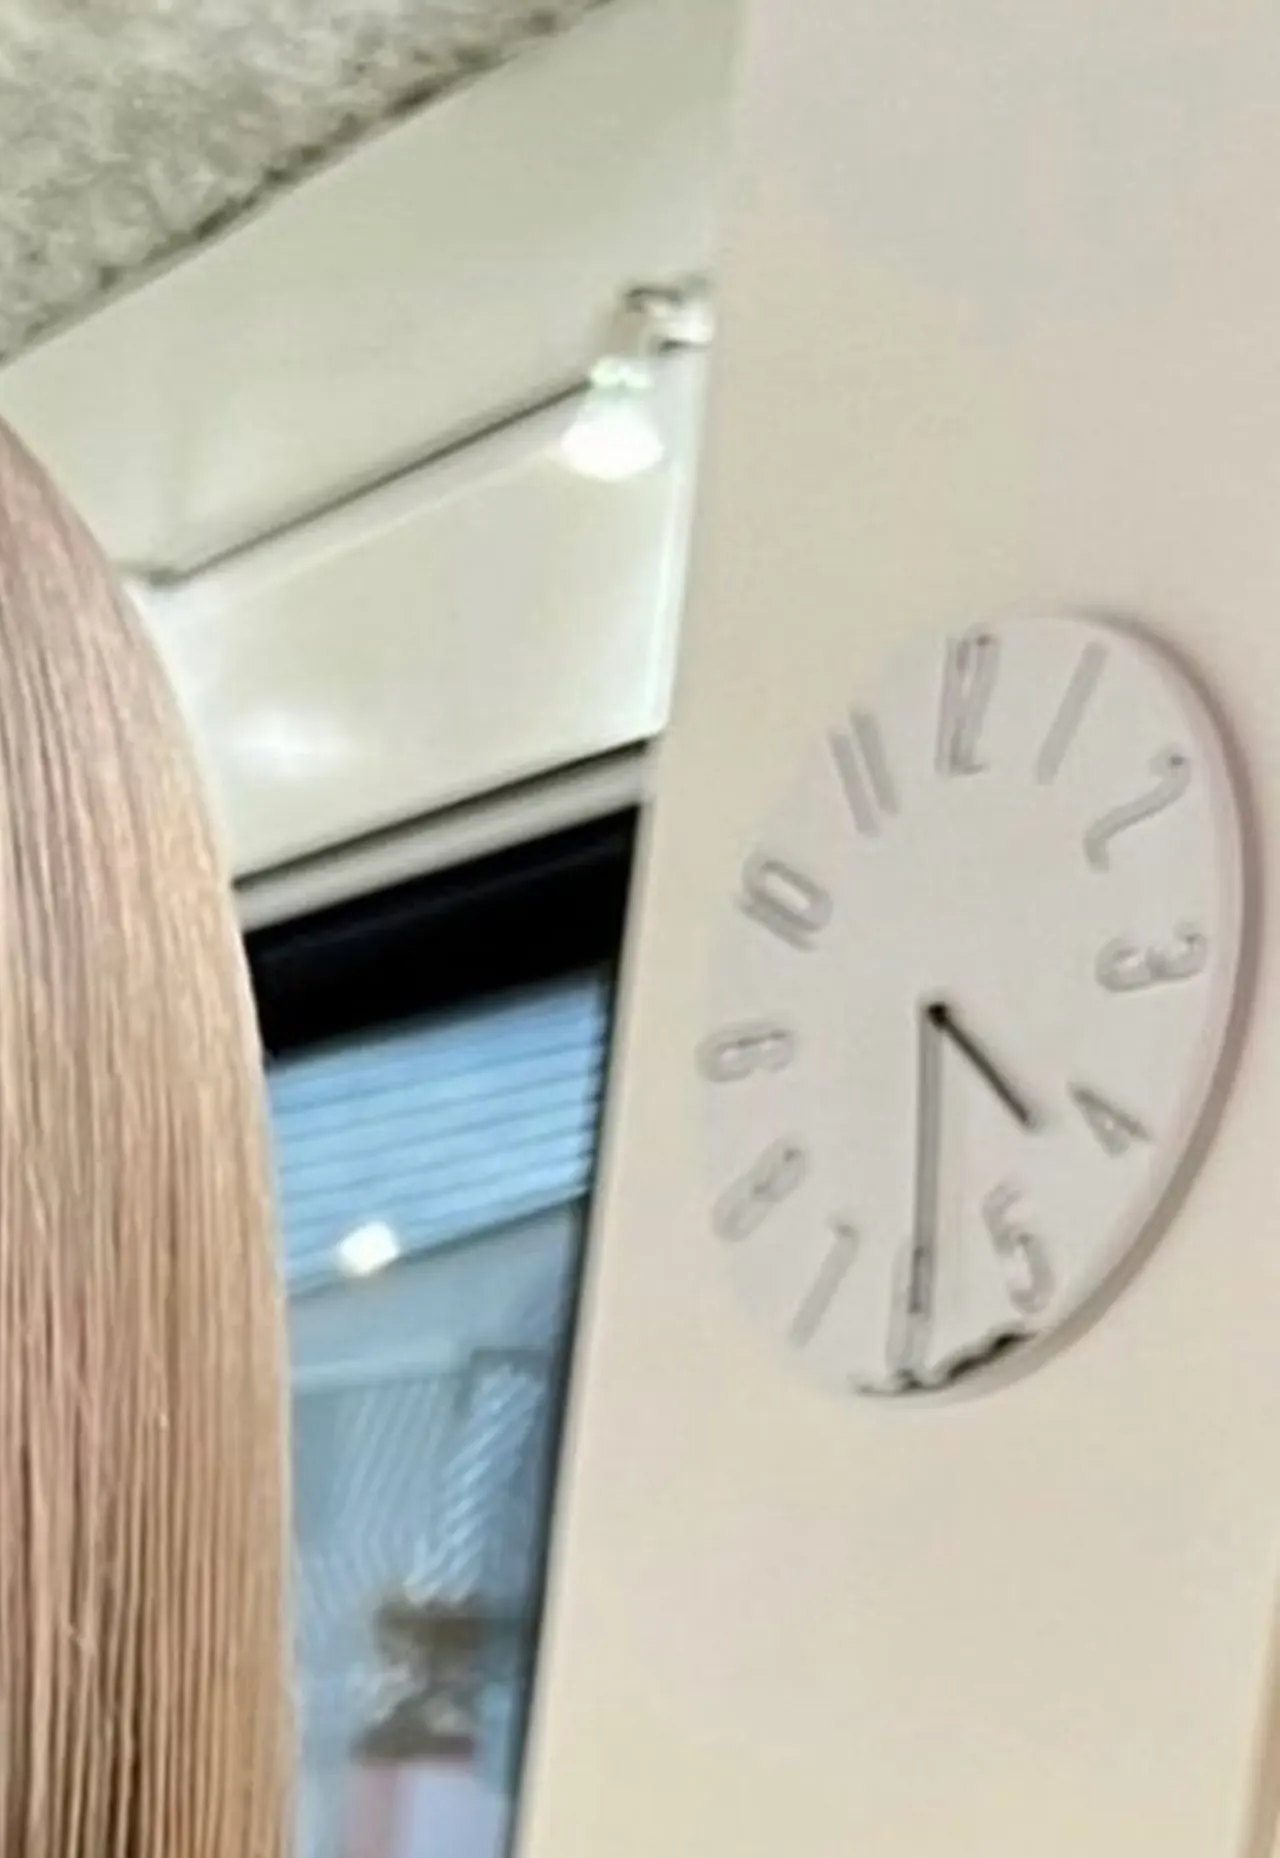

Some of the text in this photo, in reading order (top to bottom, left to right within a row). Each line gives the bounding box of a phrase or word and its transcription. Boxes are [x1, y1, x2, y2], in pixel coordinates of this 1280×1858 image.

[826, 705, 900, 838] 11
[1037, 641, 1110, 786] 1
[1082, 746, 1192, 873] 2
[736, 852, 834, 952] 10
[1094, 922, 1208, 993] 3
[694, 1025, 795, 1083] 9
[1067, 1080, 1155, 1157] 4
[712, 1138, 807, 1243] 8
[981, 1180, 1056, 1314] 5
[788, 1218, 860, 1348] 7
